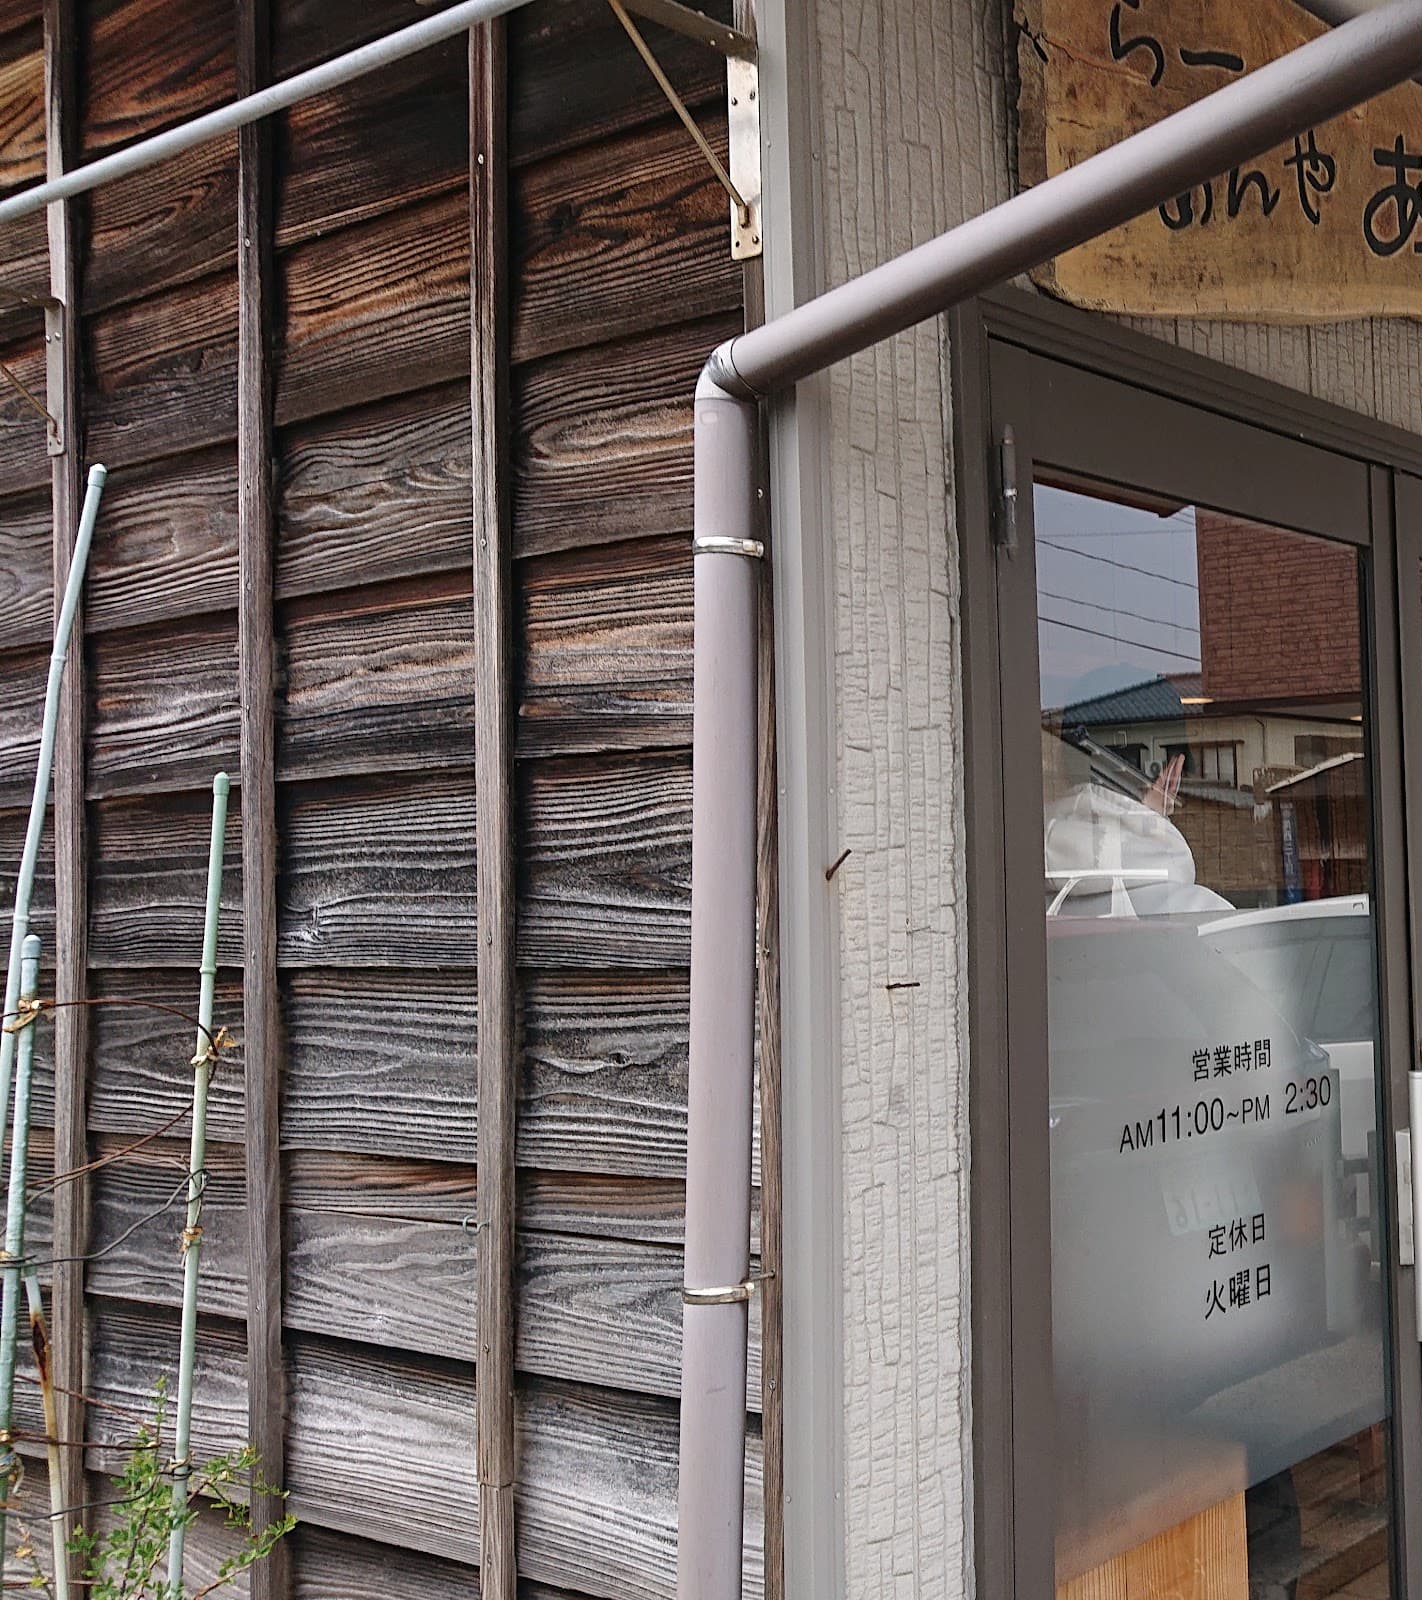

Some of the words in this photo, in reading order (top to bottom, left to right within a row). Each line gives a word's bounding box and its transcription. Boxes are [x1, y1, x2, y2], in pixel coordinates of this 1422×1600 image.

[1192, 1038, 1272, 1082] 営業時間
[1208, 1213, 1266, 1259] 定休日
[1204, 1263, 1272, 1320] 火曜日
